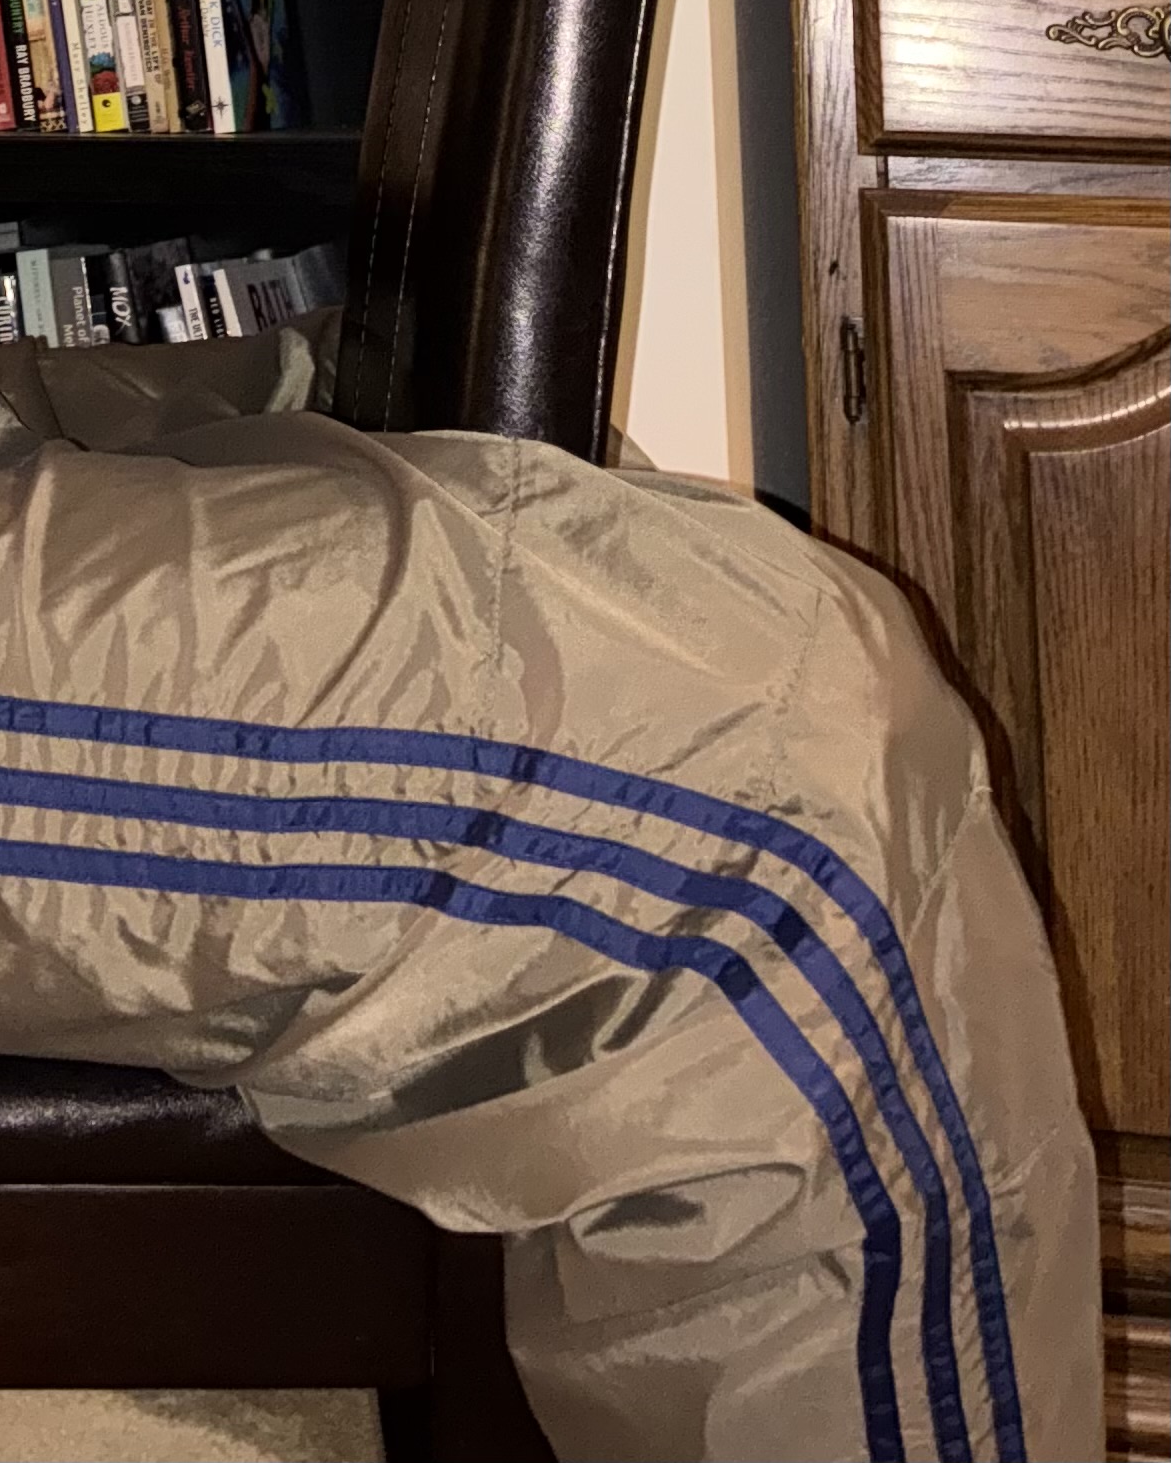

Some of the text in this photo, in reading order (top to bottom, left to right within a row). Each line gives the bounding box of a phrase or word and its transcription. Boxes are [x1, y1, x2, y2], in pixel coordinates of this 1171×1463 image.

[96, 4, 109, 49] ALDOUS
[210, 18, 223, 48] DICK
[14, 44, 31, 65] RAY
[69, 42, 83, 73] Mary
[151, 50, 160, 71] LIFE
[17, 67, 37, 122] BRADBURY
[75, 78, 89, 126] Shelley
[72, 286, 89, 343] Planet of
[109, 286, 133, 336] MOX
[188, 307, 199, 322] THE
